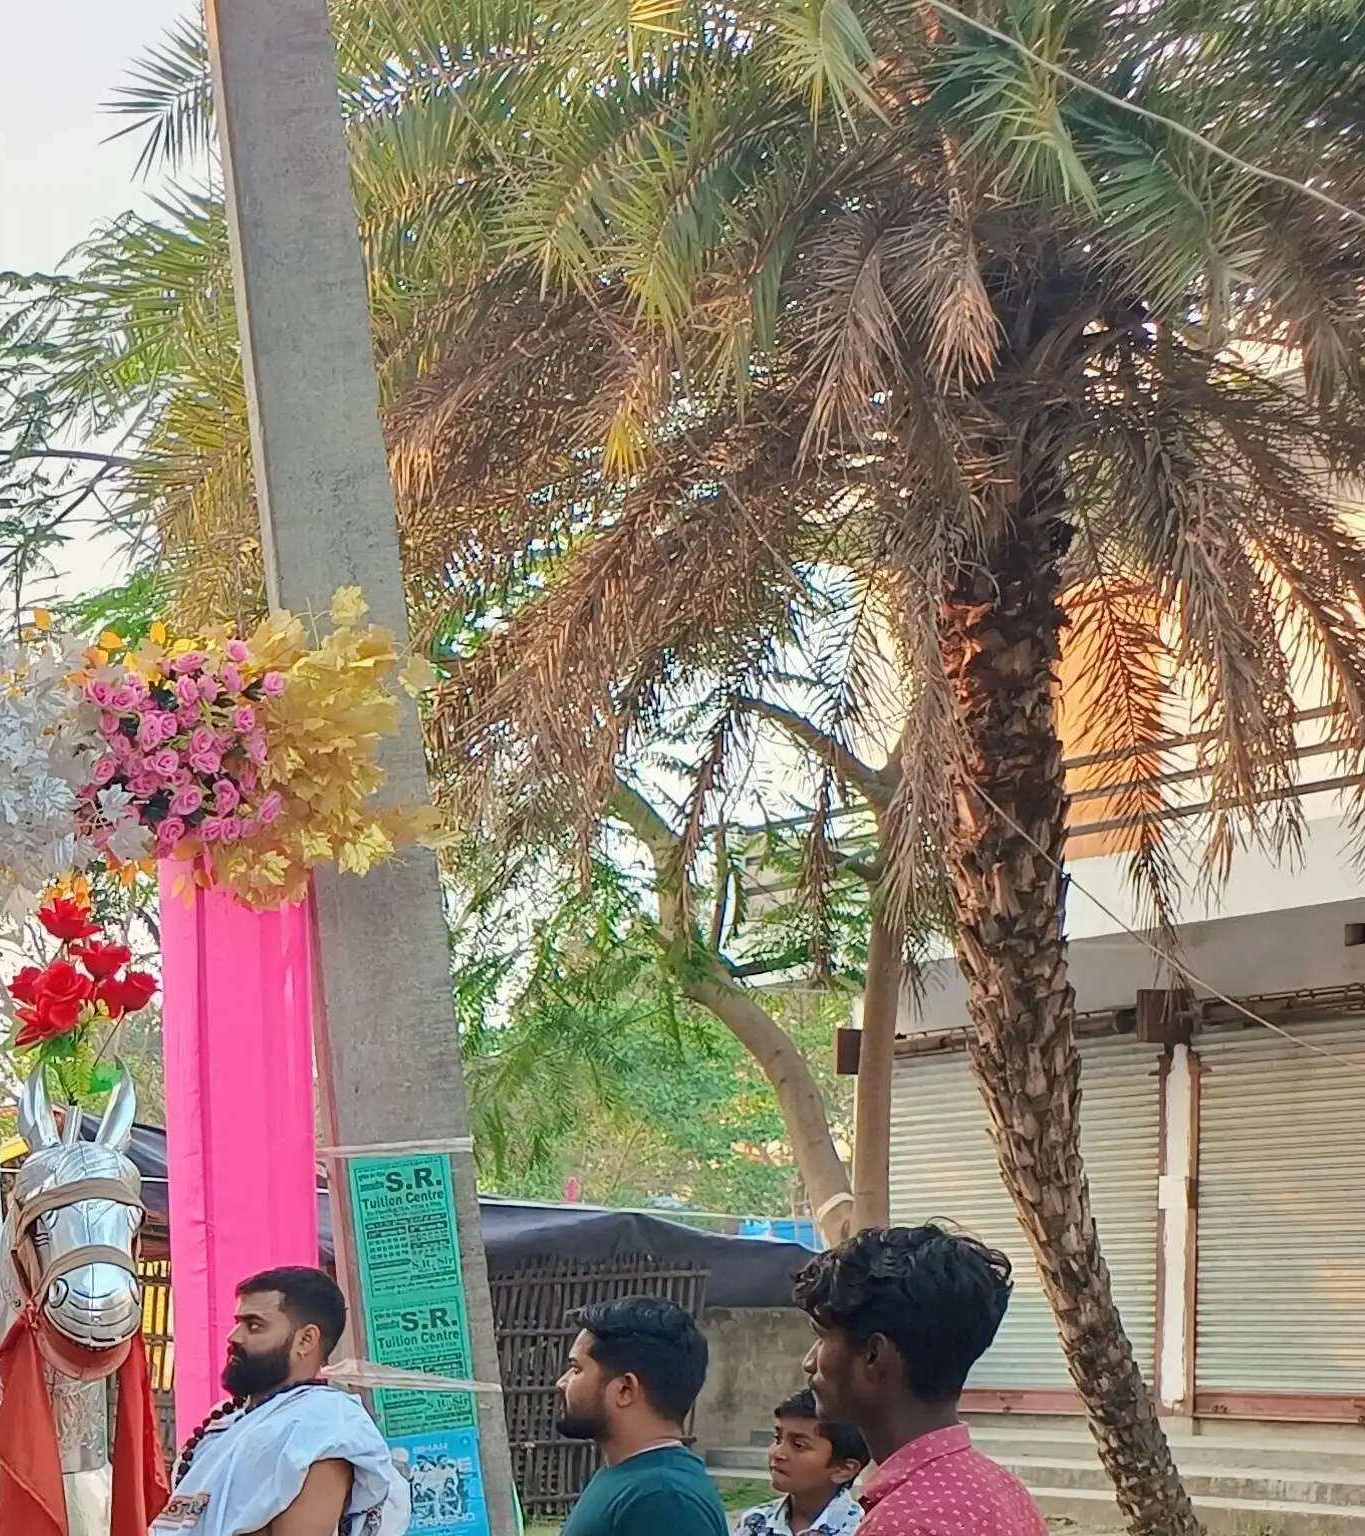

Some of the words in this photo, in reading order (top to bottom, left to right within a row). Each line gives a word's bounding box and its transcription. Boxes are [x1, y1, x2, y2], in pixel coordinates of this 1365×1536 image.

[385, 1167, 442, 1193] S.R.
[361, 1195, 402, 1210] Tuition
[405, 1190, 444, 1203] Centre
[401, 1307, 458, 1332] S.R.
[377, 1335, 418, 1350] Tuition
[420, 1329, 459, 1343] Centre
